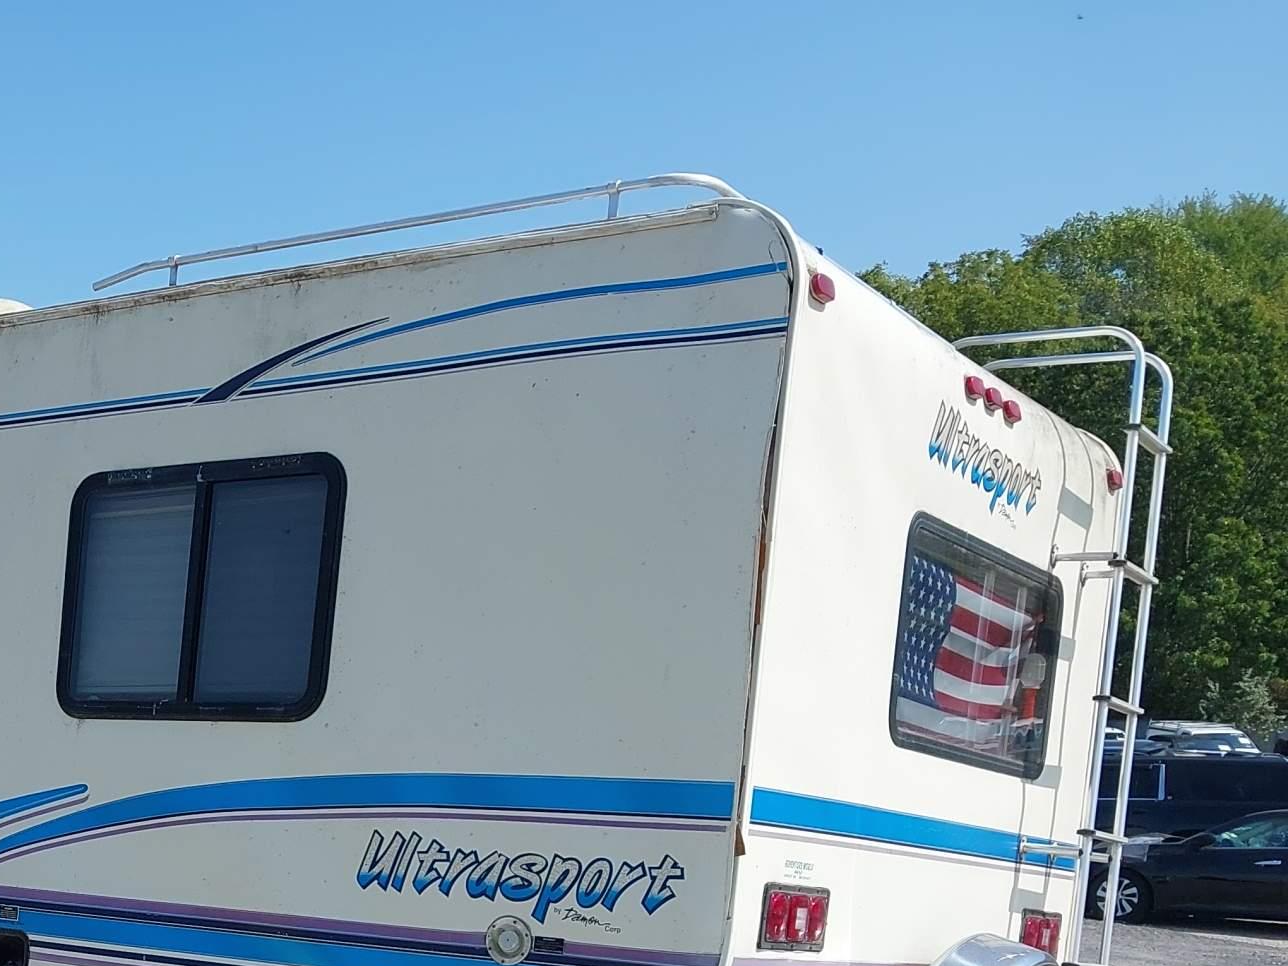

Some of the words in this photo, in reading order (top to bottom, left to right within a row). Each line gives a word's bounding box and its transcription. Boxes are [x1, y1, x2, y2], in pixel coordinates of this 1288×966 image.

[928, 399, 1042, 516] Ultrasport
[356, 829, 685, 925] Ultrasport
[553, 907, 562, 915] by
[561, 907, 612, 928] Damon
[604, 925, 622, 934] Corp
